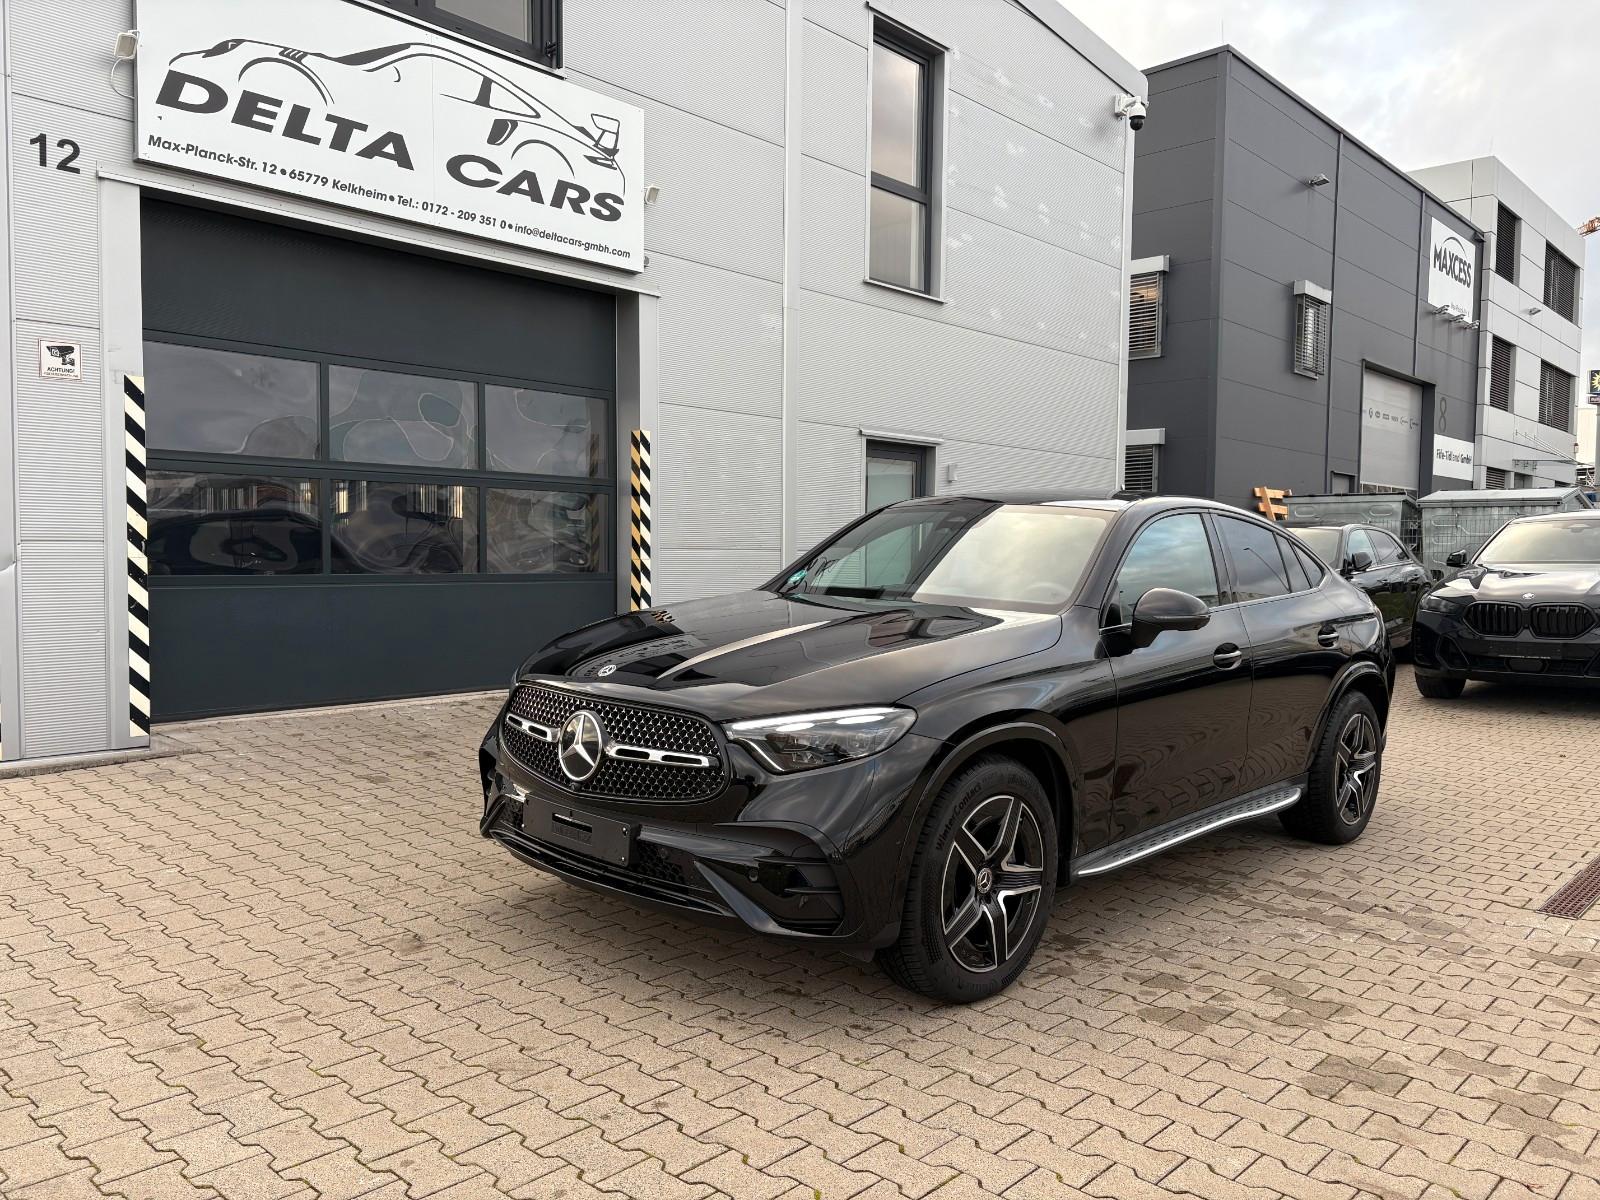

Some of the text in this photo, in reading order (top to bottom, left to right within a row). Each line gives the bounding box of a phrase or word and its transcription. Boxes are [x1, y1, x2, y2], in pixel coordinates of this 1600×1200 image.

[29, 133, 81, 175] 12
[156, 69, 625, 223] DELTA CARS
[148, 134, 259, 171] Max-Planck-Str.
[262, 161, 278, 175] 12
[288, 168, 329, 187] 65779
[331, 179, 388, 202] Kelkheim
[397, 195, 419, 209] Tel.:
[421, 201, 449, 216] 0172
[456, 209, 477, 222] 209
[479, 214, 497, 228] 351
[499, 219, 507, 230] 0
[514, 223, 631, 259] info@deltacars-gmbh.com
[1433, 243, 1472, 289] MAXCESS
